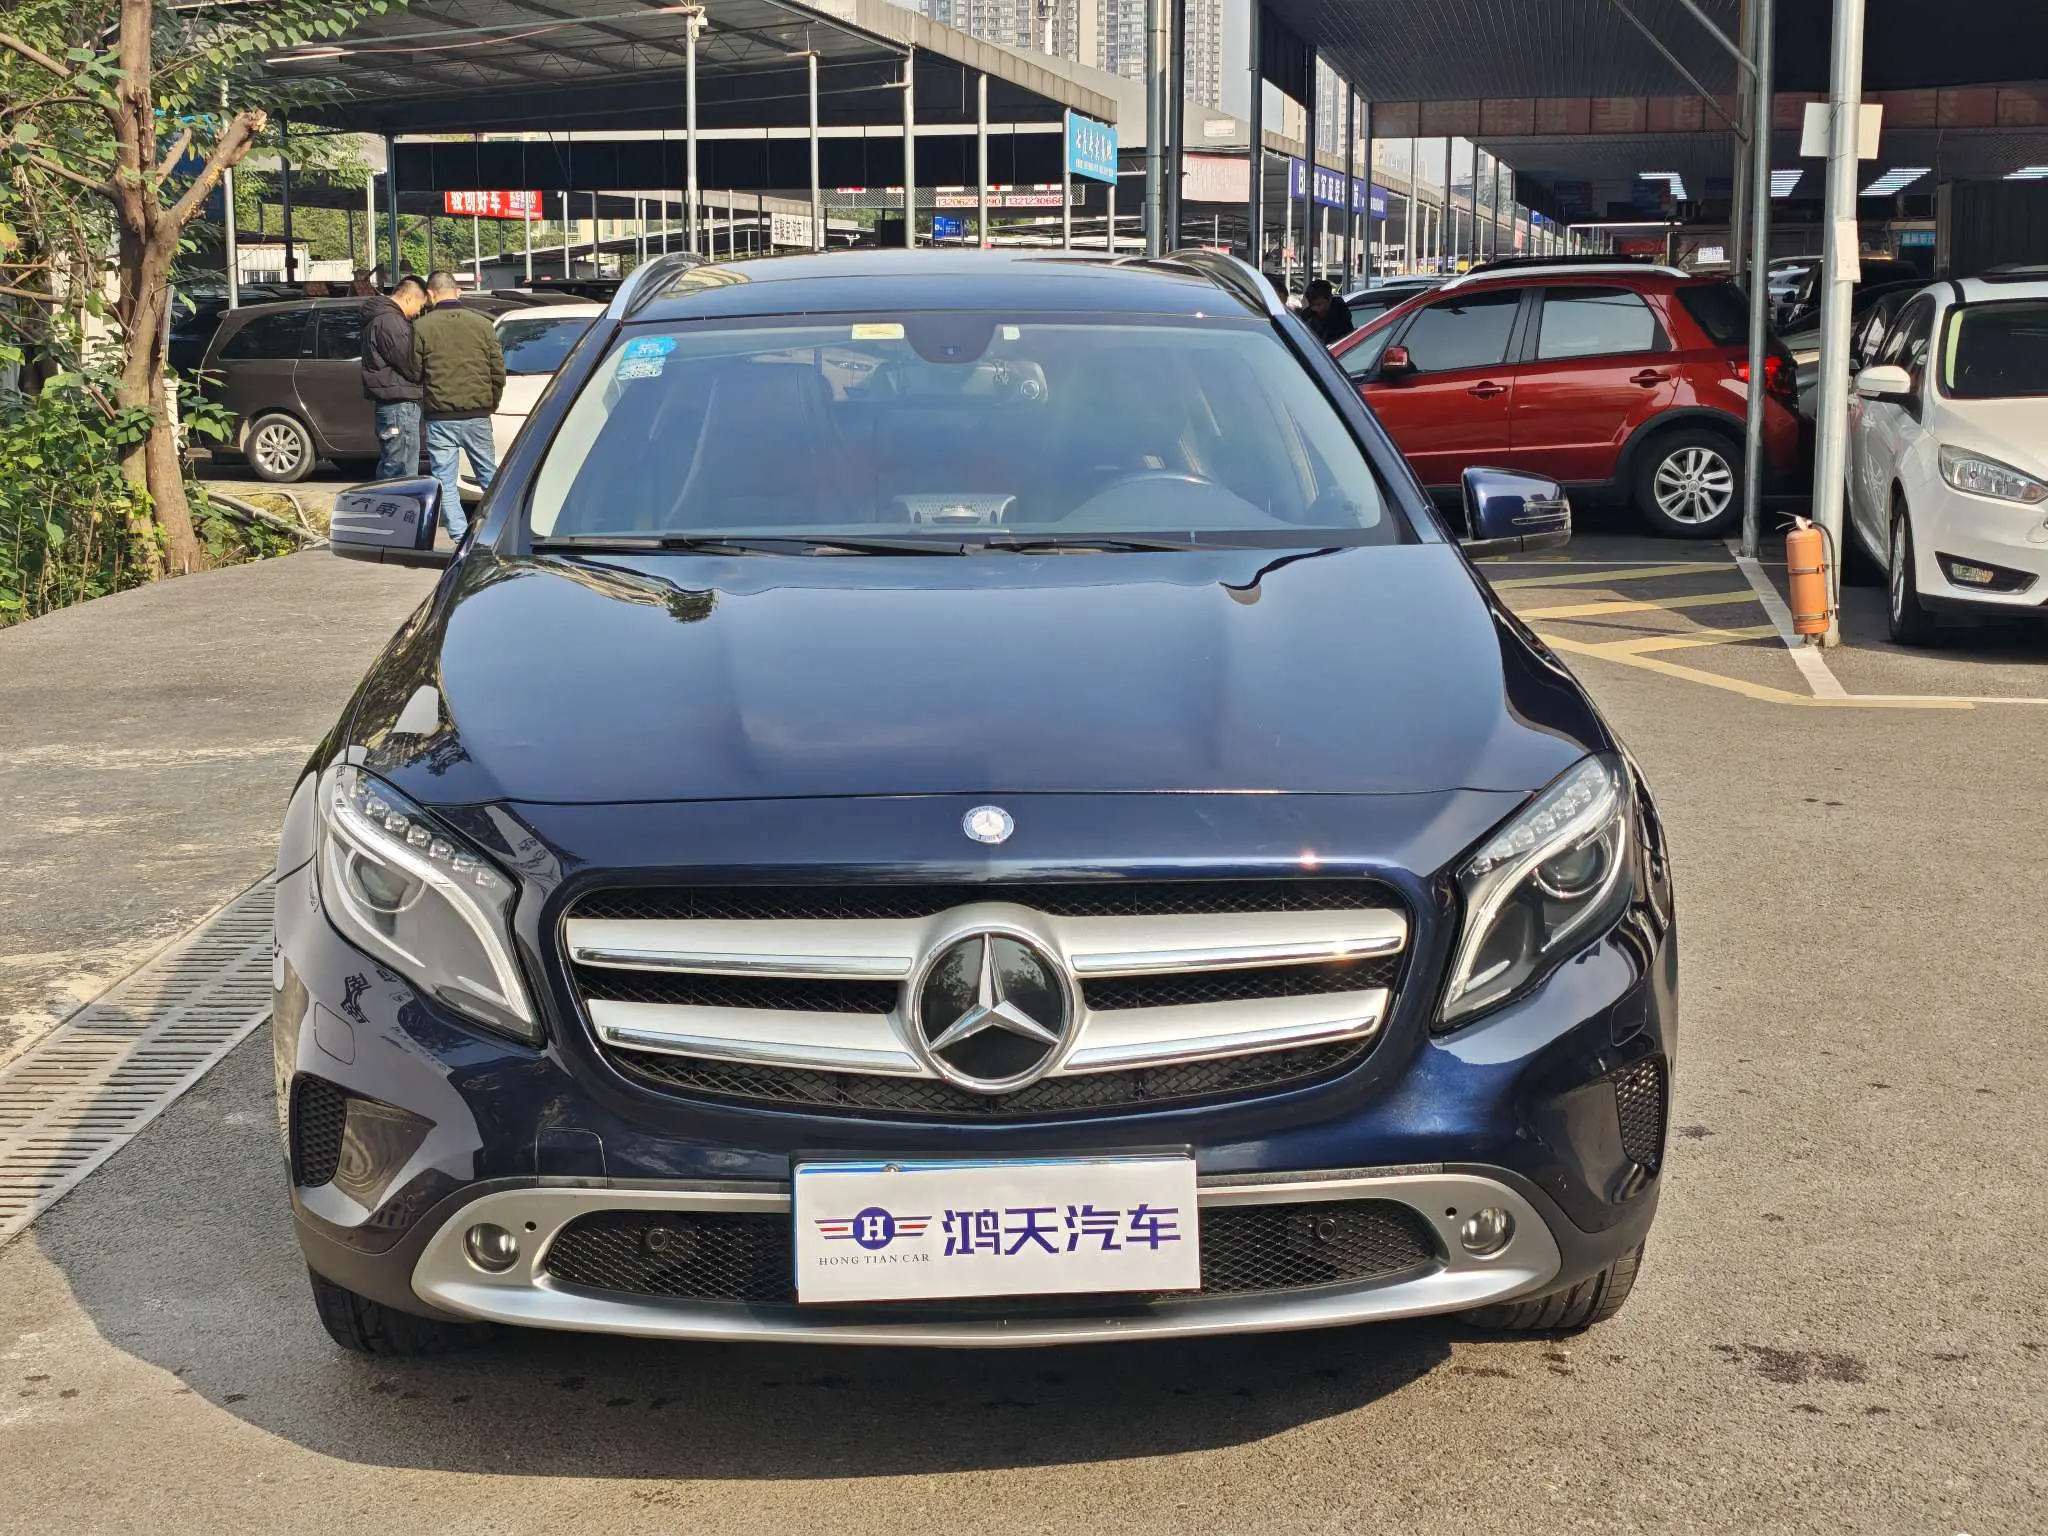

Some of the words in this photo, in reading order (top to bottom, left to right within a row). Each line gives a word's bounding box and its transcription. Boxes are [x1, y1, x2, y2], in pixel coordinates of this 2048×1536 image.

[942, 1203, 1181, 1256] 鸿天汽车
[818, 1256, 860, 1266] HONG
[863, 1254, 898, 1265] TIAN
[901, 1252, 930, 1264] CAR
